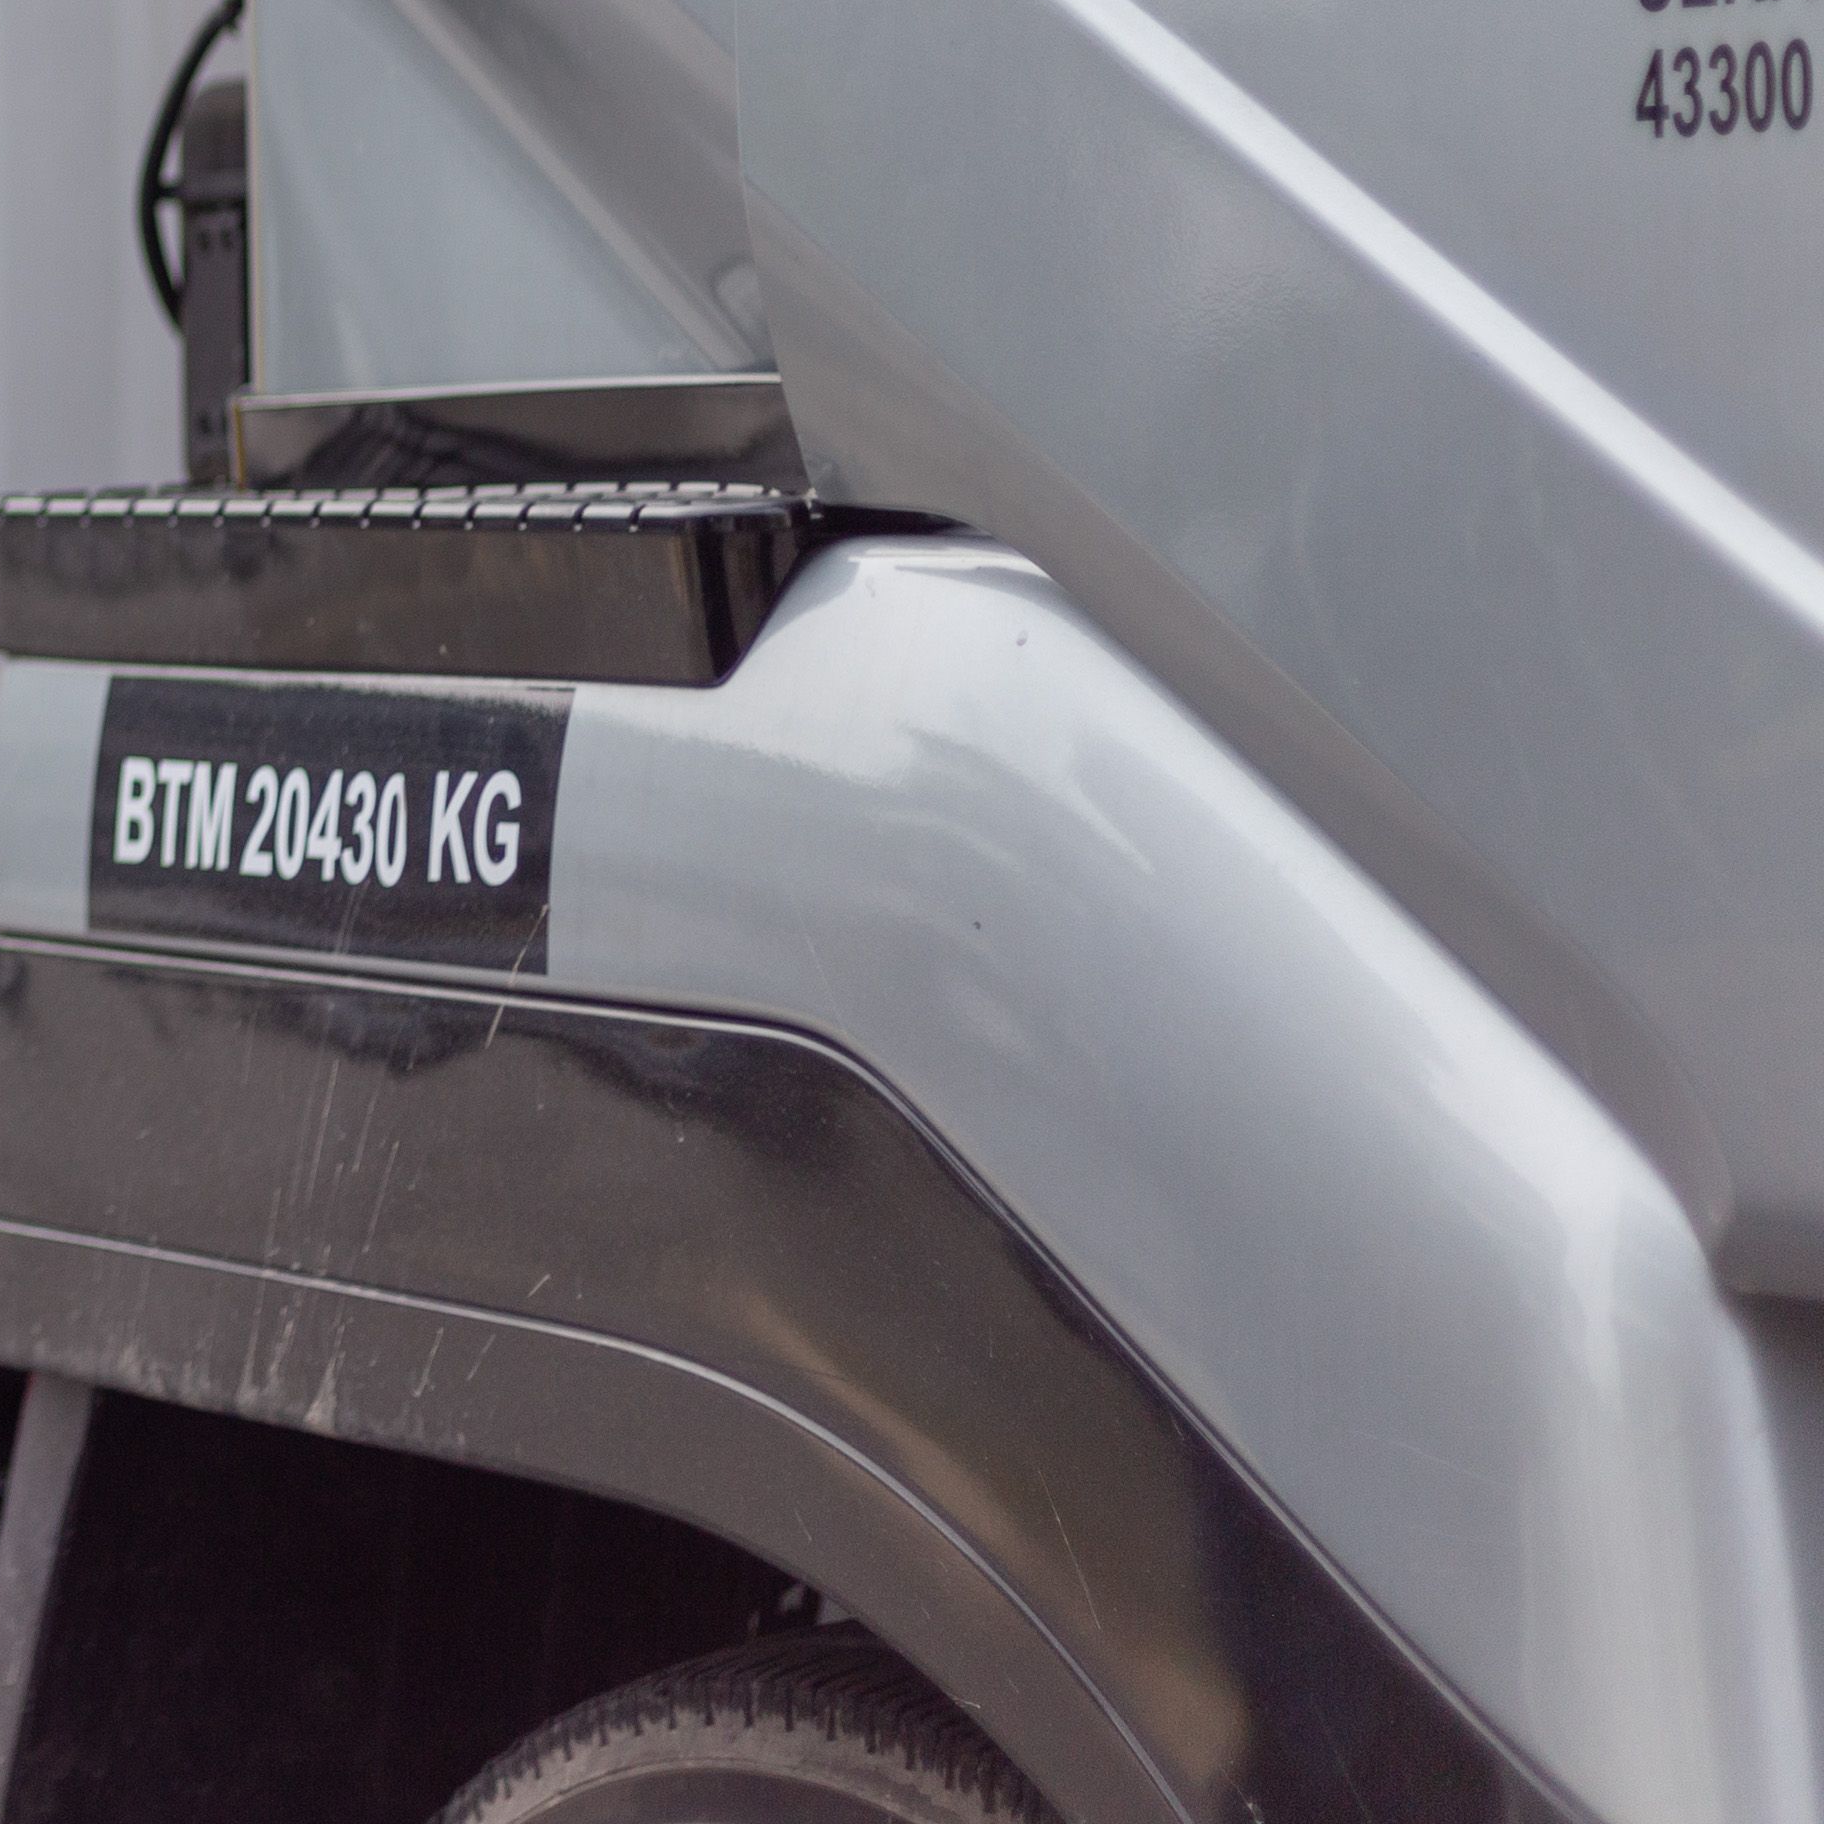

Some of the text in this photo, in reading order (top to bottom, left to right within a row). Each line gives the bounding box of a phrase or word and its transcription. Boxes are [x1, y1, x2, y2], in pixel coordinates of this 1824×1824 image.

[1635, 38, 1815, 139] 43300
[113, 755, 523, 888] BTM 20430 KG
